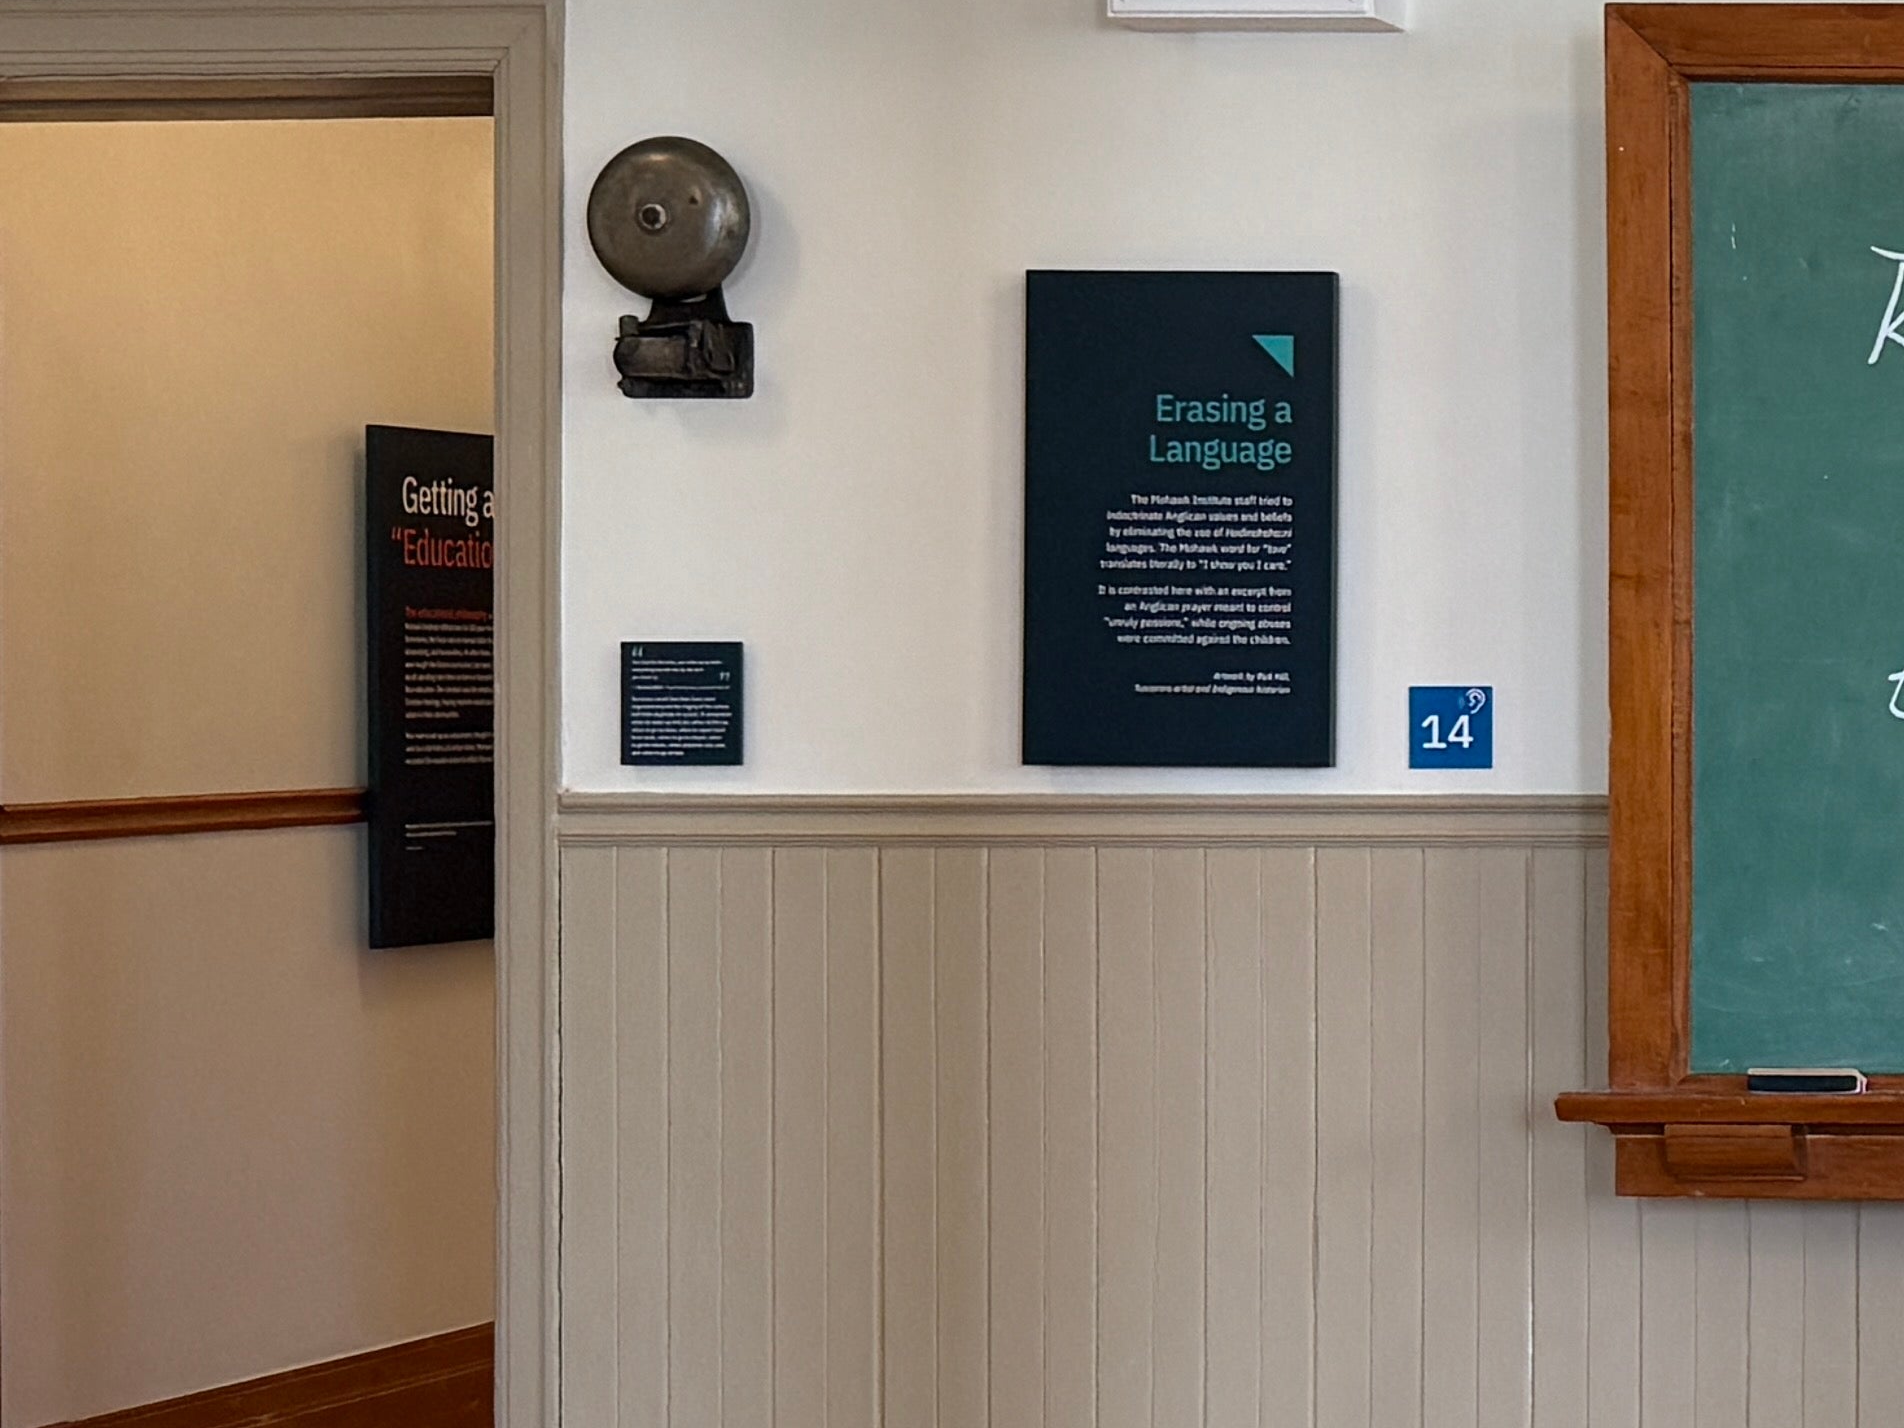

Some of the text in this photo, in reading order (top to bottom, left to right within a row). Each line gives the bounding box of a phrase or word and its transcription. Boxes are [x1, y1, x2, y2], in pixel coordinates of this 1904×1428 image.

[1156, 393, 1293, 431] Erasing a
[1150, 434, 1292, 470] Language
[402, 476, 479, 527] Getting
[391, 527, 495, 568] “Educatio
[1421, 714, 1474, 749] 14
